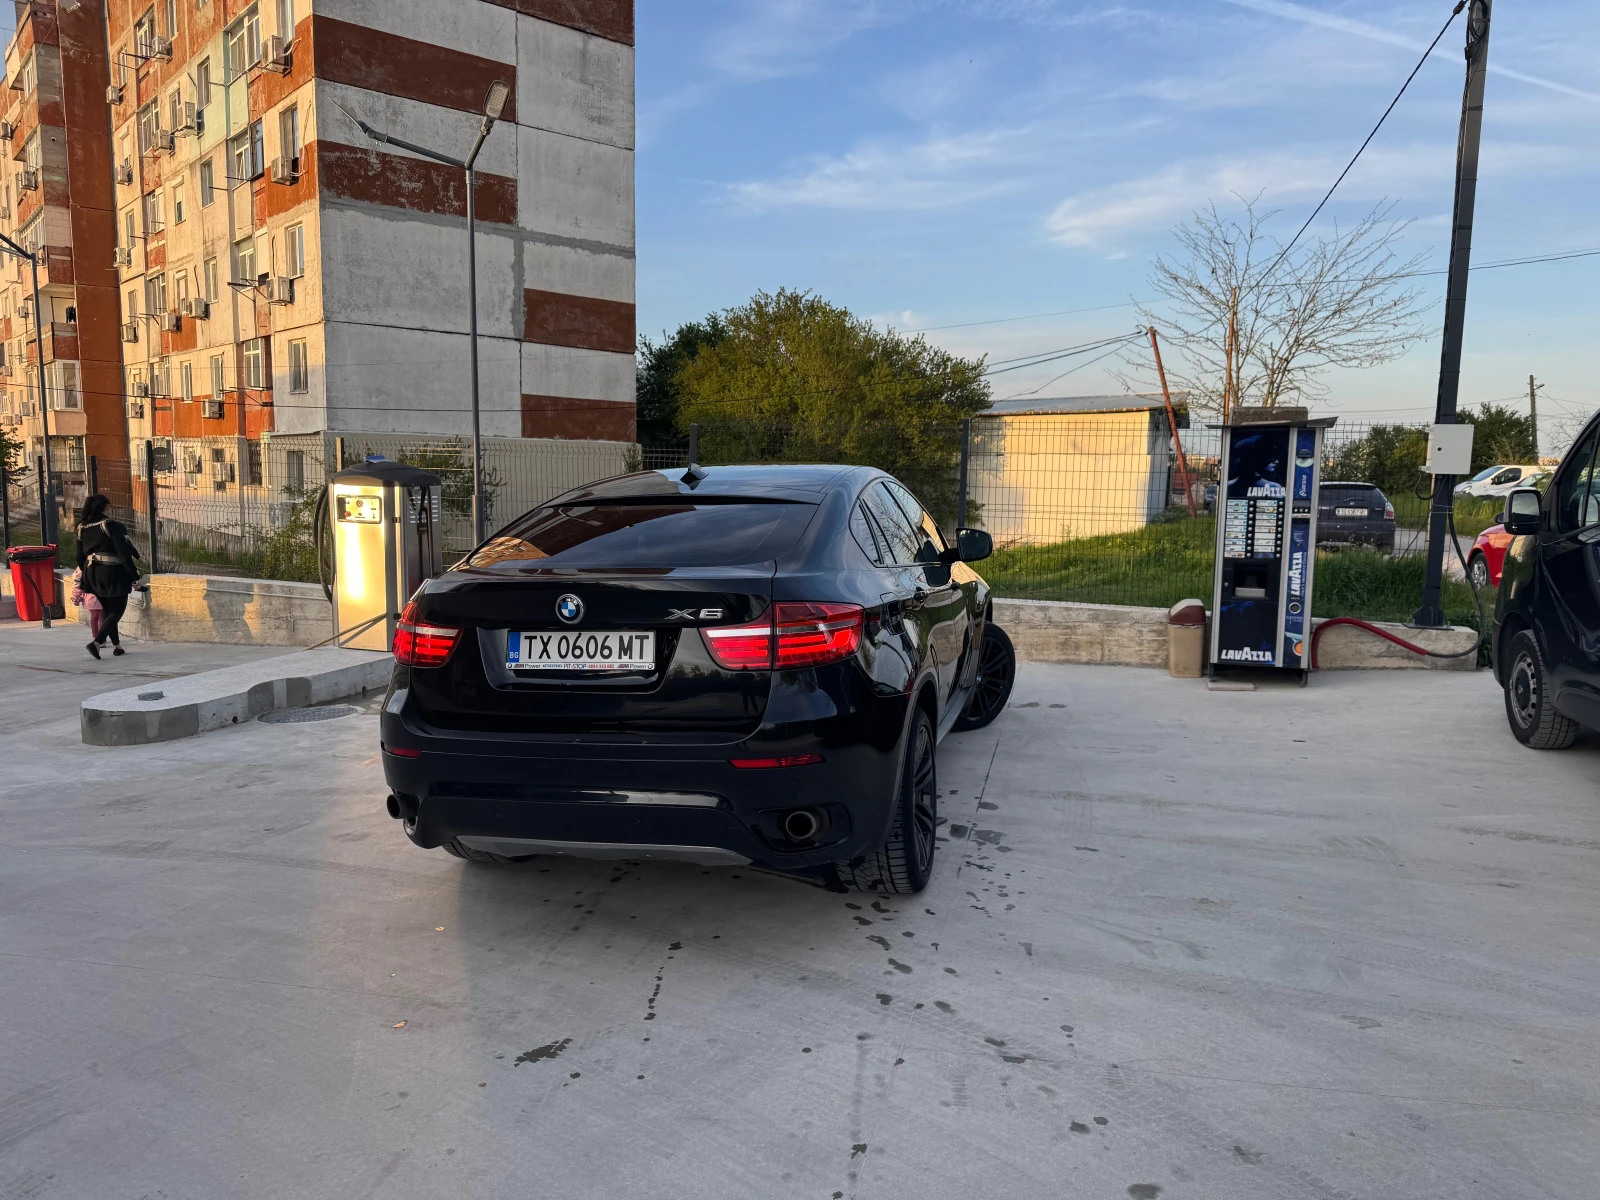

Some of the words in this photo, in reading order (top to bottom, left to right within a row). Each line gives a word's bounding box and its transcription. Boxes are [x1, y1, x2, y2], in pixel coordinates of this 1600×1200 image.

[1247, 484, 1286, 497] LAVAZZA
[1289, 552, 1303, 596] LAVAZZA
[664, 608, 724, 620] X6
[524, 635, 552, 660] TX
[557, 634, 613, 660] 0606
[618, 634, 650, 660] MT
[509, 651, 519, 659] BG
[1221, 647, 1272, 661] LAVAZZA
